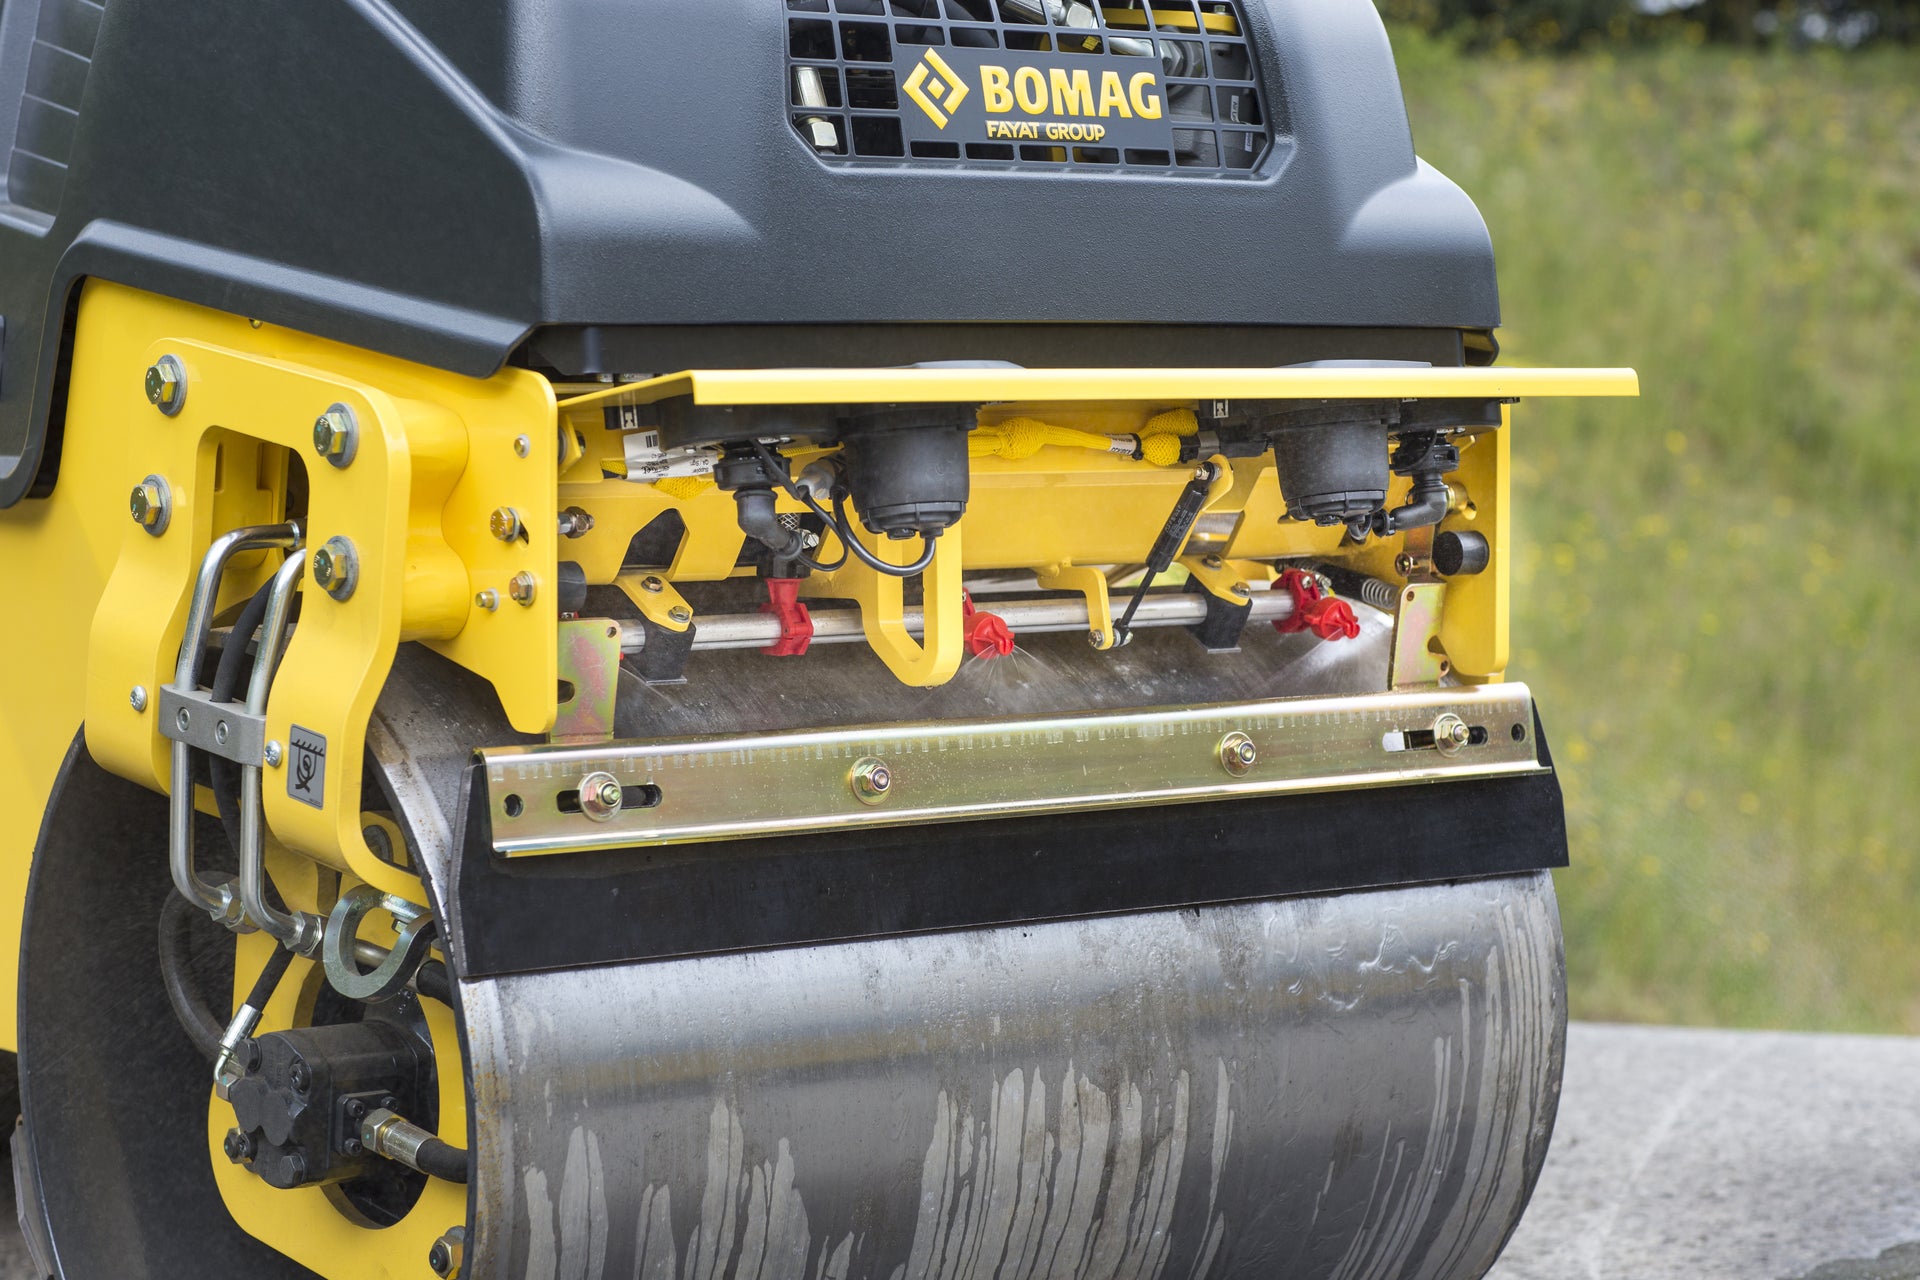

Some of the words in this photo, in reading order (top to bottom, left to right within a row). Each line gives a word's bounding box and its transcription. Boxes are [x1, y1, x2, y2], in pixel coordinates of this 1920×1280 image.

[979, 65, 1162, 120] BOMAG
[986, 120, 1040, 139] FAYAT
[1045, 122, 1106, 141] GROUP
